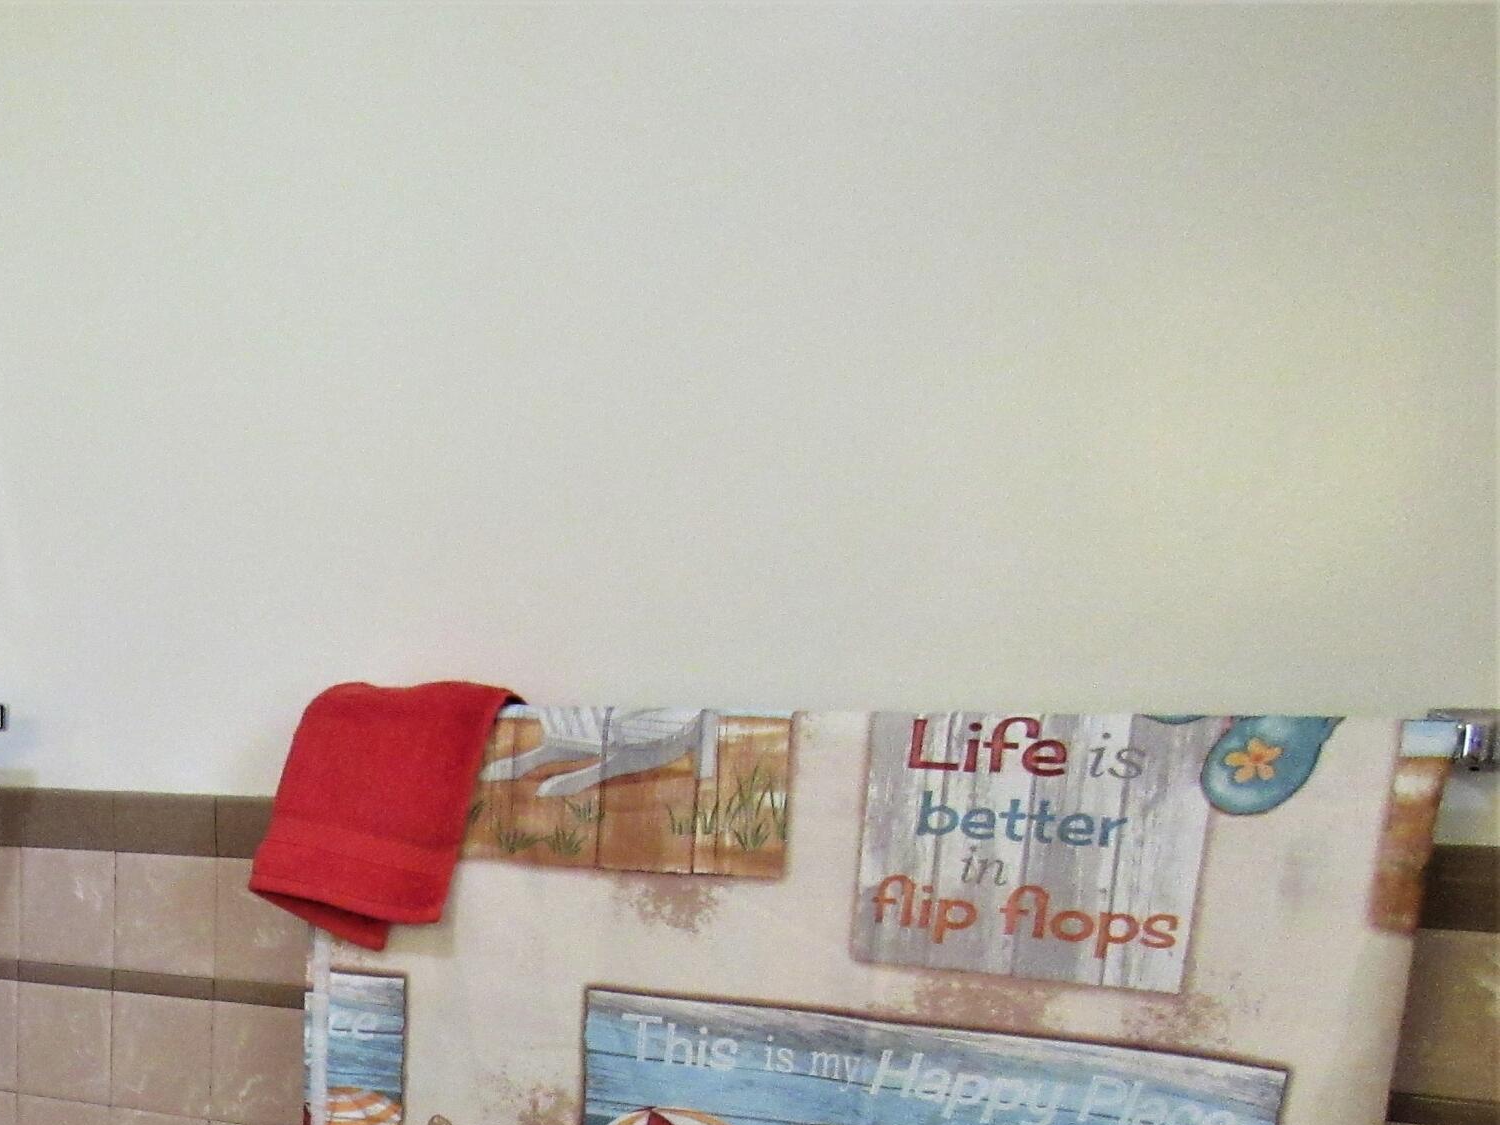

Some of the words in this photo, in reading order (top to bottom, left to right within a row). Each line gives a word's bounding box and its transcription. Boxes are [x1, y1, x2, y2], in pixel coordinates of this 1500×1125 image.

[907, 716, 1068, 777] Life
[1088, 732, 1146, 779] is
[916, 790, 1128, 847] better
[960, 846, 1007, 886] in
[872, 874, 978, 944] flip
[1000, 884, 1181, 959] flops
[621, 1012, 739, 1072] This
[764, 1034, 795, 1073] is
[810, 1049, 862, 1092] my
